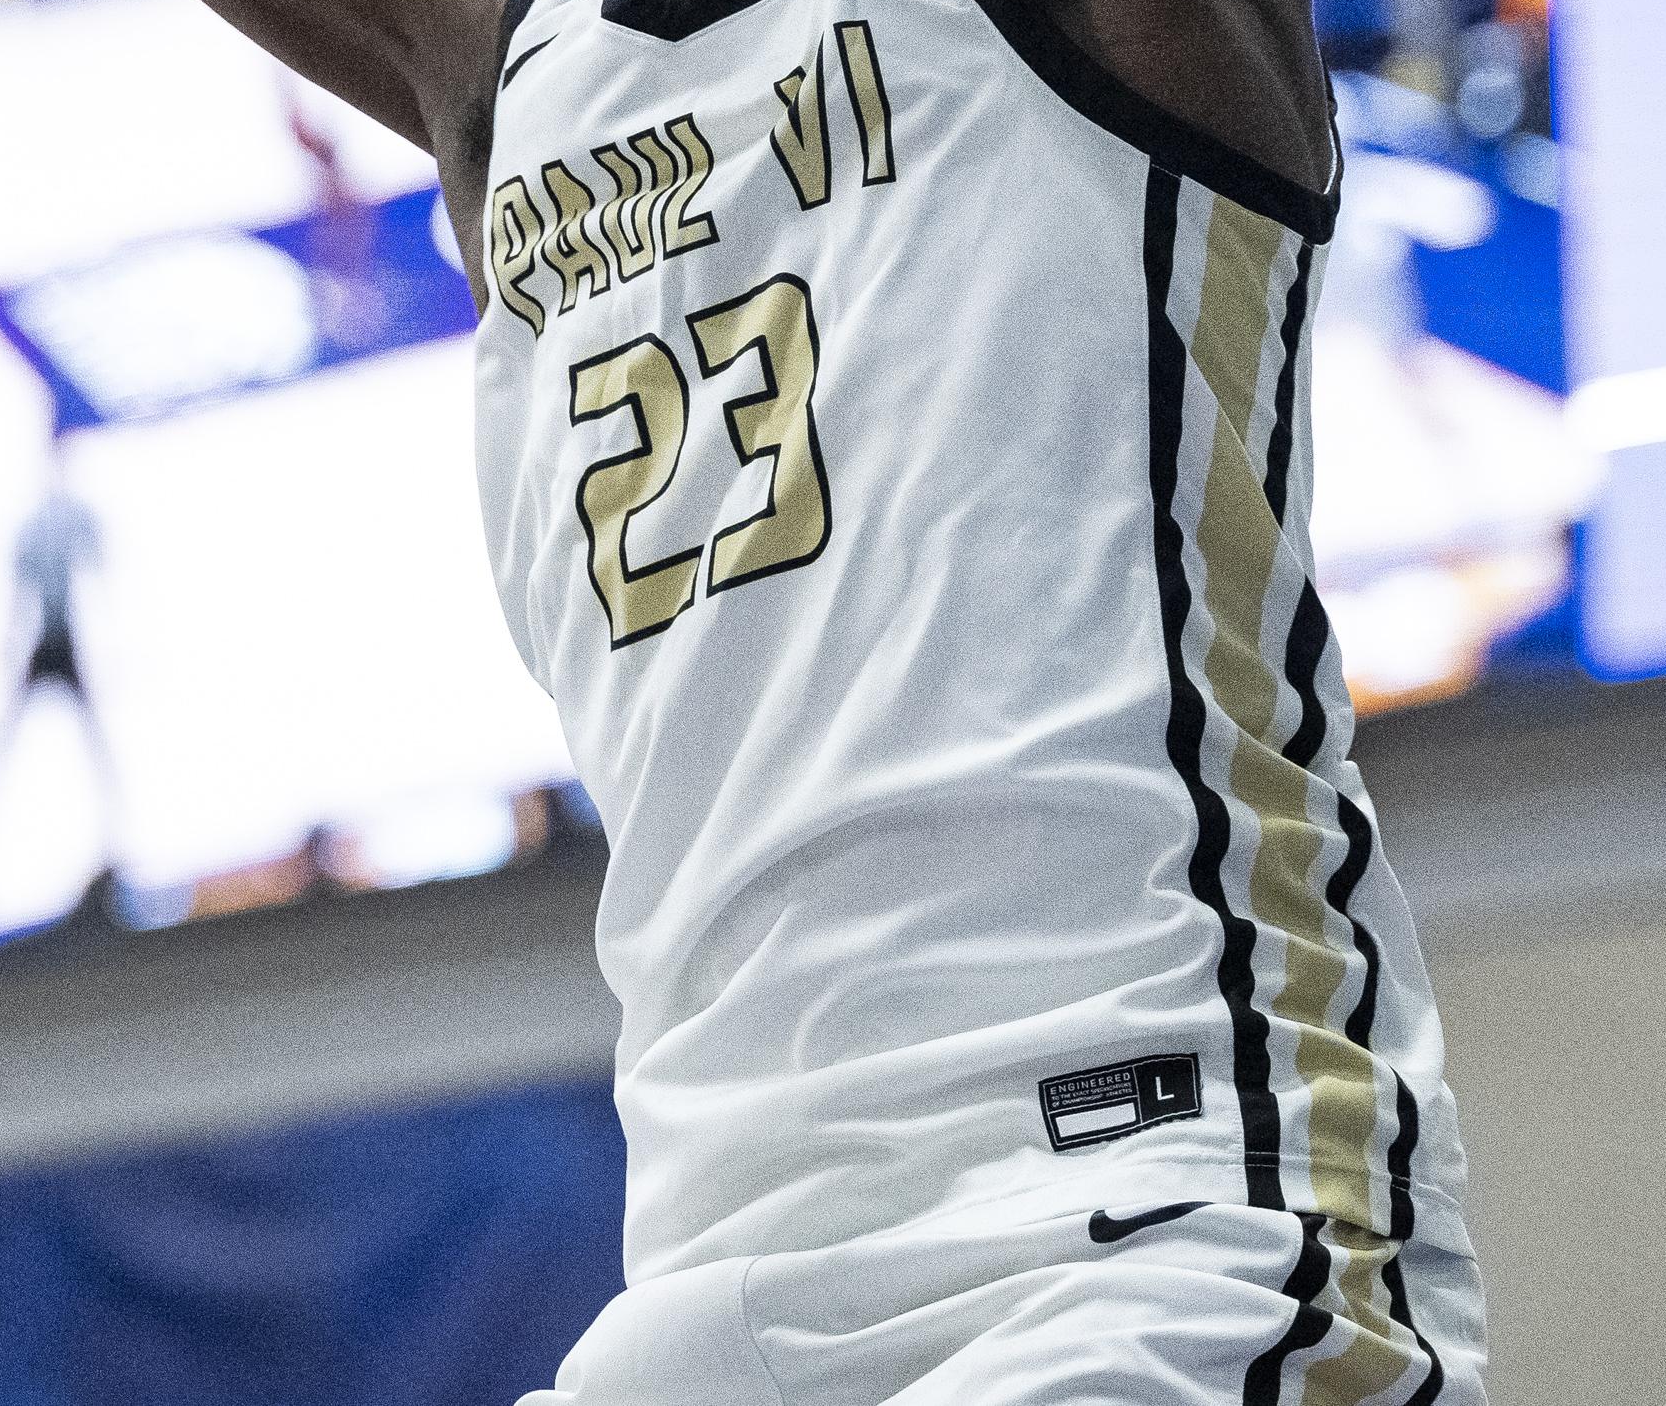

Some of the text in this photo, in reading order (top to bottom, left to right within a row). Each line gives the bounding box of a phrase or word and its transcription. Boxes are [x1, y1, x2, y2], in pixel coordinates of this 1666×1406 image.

[491, 112, 720, 338] PAUL
[769, 20, 896, 211] VI
[569, 272, 832, 651] 23
[1050, 1072, 1131, 1095] ENGINEERED
[1155, 1076, 1175, 1101] L
